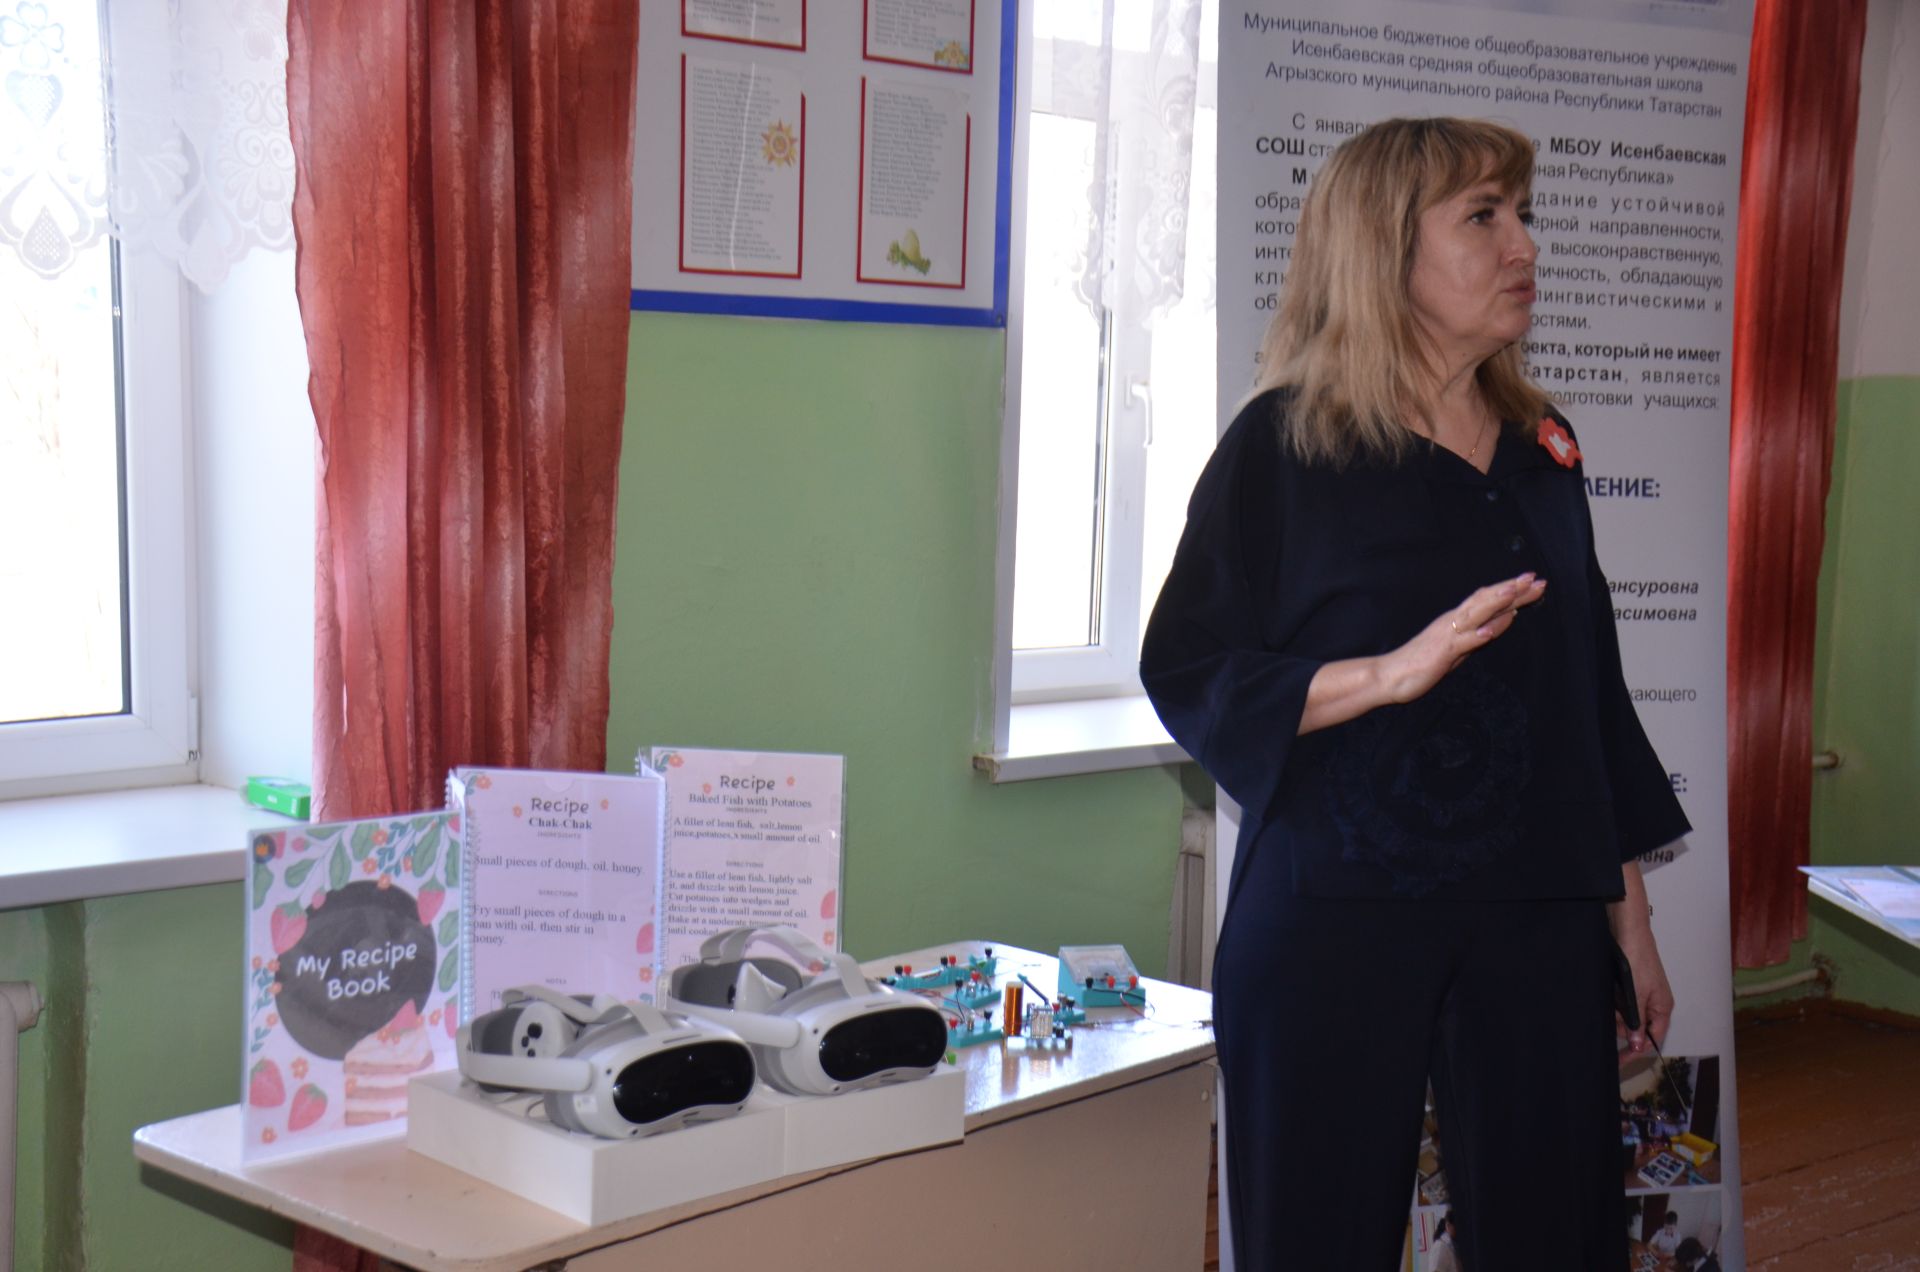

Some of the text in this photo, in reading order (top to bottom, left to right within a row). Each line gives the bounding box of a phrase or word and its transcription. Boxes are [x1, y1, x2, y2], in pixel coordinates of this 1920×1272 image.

[1244, 12, 1738, 76] Муниципальное бюджетное общеобразовательное учреждение
[1292, 40, 1704, 94] Исенбаевская средняя общеобразовательная школа
[1265, 61, 1722, 119] Агрызского муниципального района Республики Татарстан
[1292, 112, 1370, 135] С январ
[1256, 136, 1305, 156] СОШ
[1550, 137, 1602, 157] МБОУ
[1611, 140, 1727, 166] Исенбаевская
[1569, 163, 1674, 187] Республика»
[1255, 191, 1303, 213] обра
[1531, 191, 1726, 217] дание устойчивой
[1255, 220, 1298, 236] кото
[1531, 215, 1725, 244] ерной направленности,
[1551, 241, 1724, 267] высоконравственную,
[1620, 266, 1723, 292] обладающую
[1714, 300, 1722, 312] и
[1575, 342, 1650, 361] который
[1654, 347, 1674, 361] не
[1677, 349, 1721, 364] имеет
[1641, 370, 1721, 387] является
[1608, 580, 1700, 598] ансуровна
[1613, 607, 1698, 622] асимовна
[719, 775, 776, 794] Recipe
[531, 797, 590, 818] Recipe
[689, 793, 813, 809] Baked Fish with Potatoes
[674, 818, 682, 826] A
[684, 818, 704, 827] fillet
[706, 818, 716, 828] of
[797, 833, 807, 844] of
[505, 857, 538, 870] pieces
[540, 857, 552, 869] of
[494, 905, 521, 917] small
[524, 907, 556, 920] pieces
[558, 908, 571, 919] of
[572, 910, 605, 923] dough
[607, 911, 618, 922] in
[619, 914, 626, 923] a
[495, 921, 518, 932] with
[540, 922, 563, 934] then
[565, 924, 580, 934] stir
[584, 924, 594, 935] in
[295, 940, 418, 981] My Recipe
[326, 969, 392, 1001] Book
